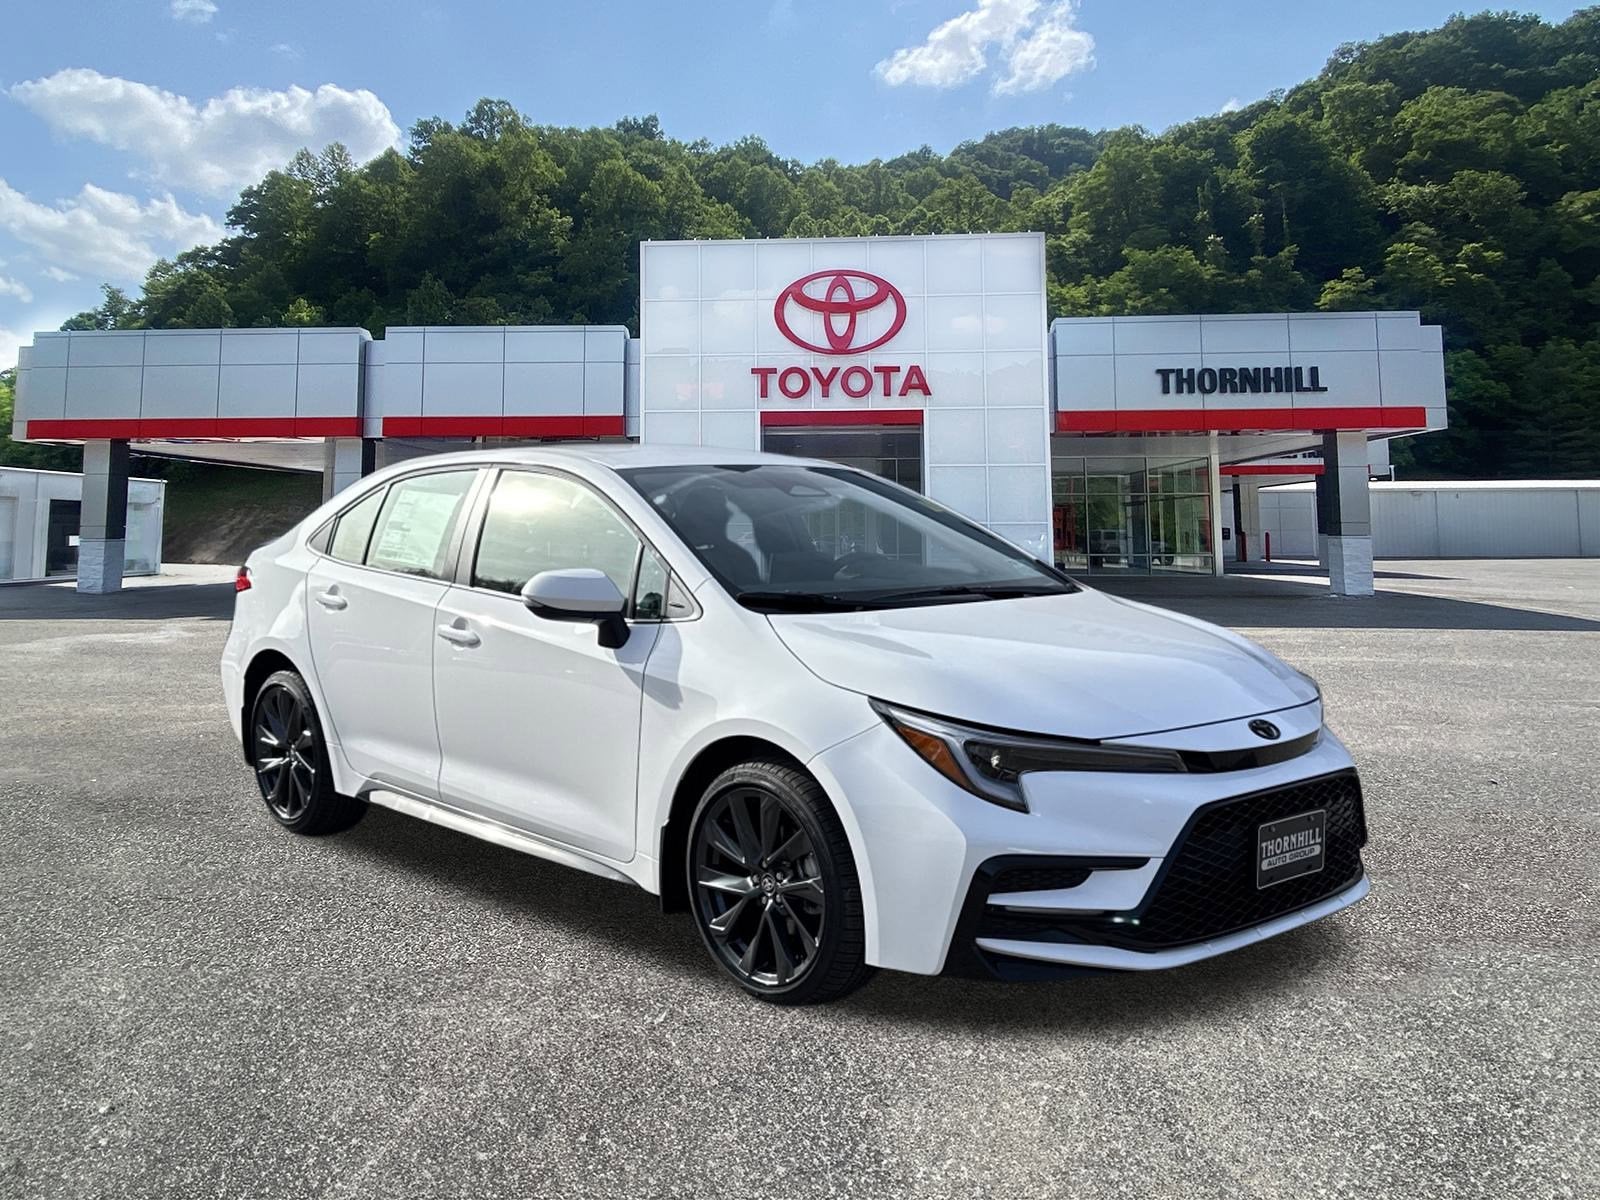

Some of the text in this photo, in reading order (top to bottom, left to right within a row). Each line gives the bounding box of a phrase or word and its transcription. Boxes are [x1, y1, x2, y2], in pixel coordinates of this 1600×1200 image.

[751, 365, 932, 399] TOYOTA
[1155, 366, 1328, 394] THORNHILL
[1261, 827, 1321, 858] THORNHILL
[1266, 847, 1315, 867] AUTO GROUP
